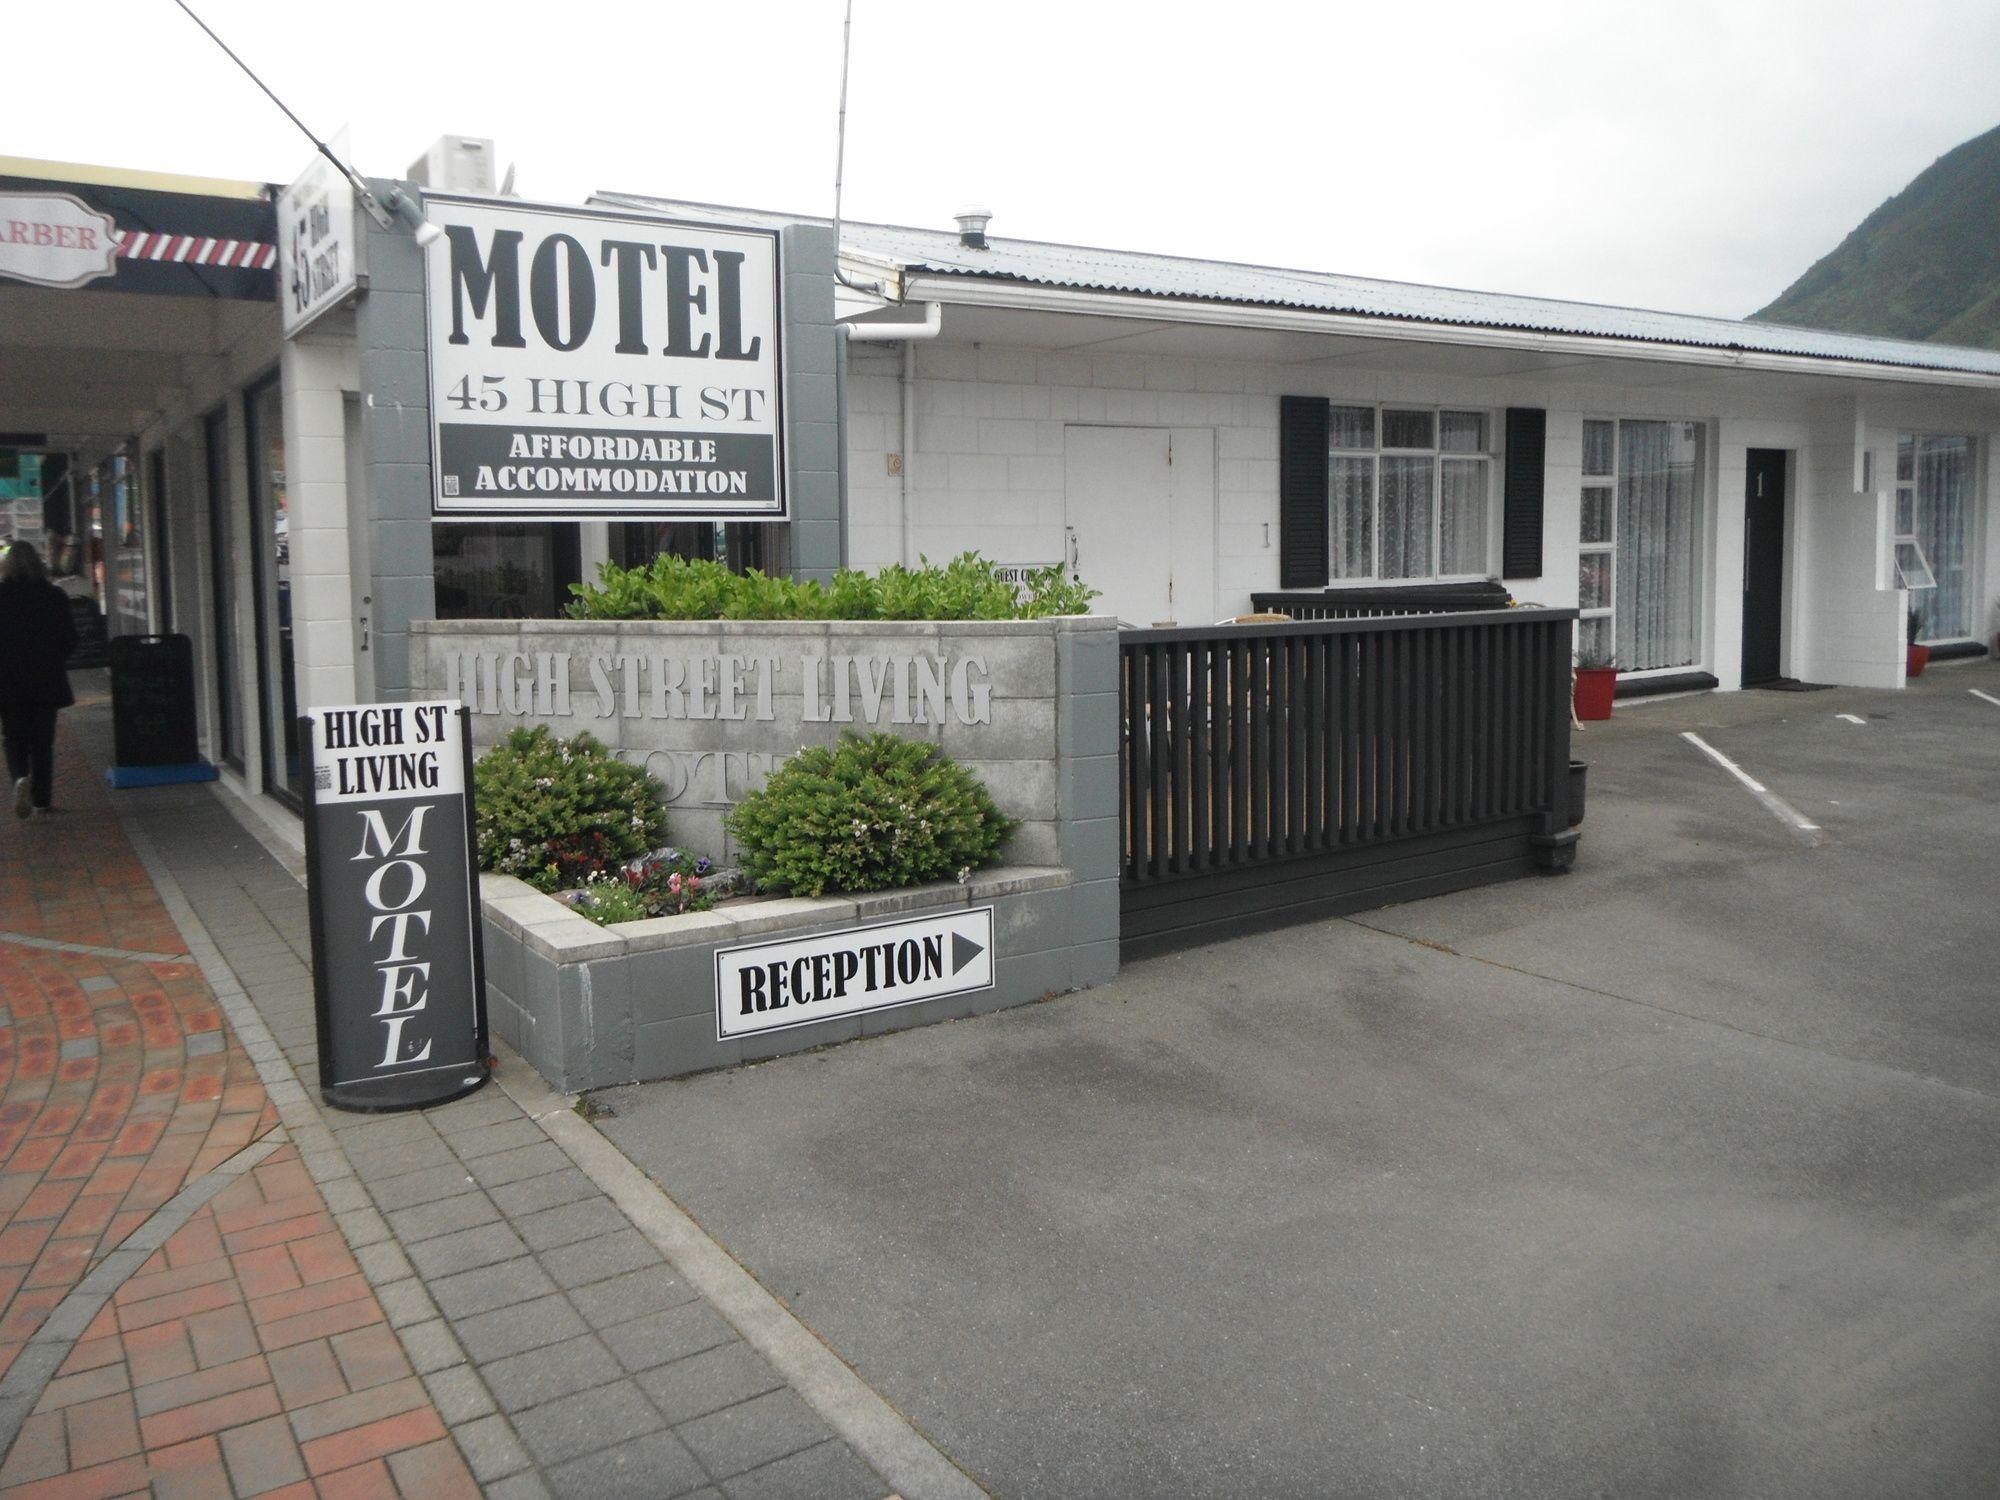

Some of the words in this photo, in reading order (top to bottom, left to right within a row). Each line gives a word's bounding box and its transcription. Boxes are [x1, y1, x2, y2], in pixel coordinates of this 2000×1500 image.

[0, 220, 98, 250] RBER
[444, 224, 762, 362] MOTEL
[446, 374, 509, 412] 45
[526, 377, 682, 420] HIGH
[700, 386, 766, 422] ST
[509, 433, 718, 464] AFFORDABLE
[475, 465, 747, 495] ACCOMMODATION
[1756, 472, 1763, 497] 1
[446, 651, 573, 717] HIGH
[588, 654, 782, 721] STREET
[801, 655, 993, 726] LIVING
[323, 706, 404, 750] HIGH
[415, 705, 448, 744] ST
[336, 752, 440, 795] LIVING
[349, 805, 436, 1069] MOTEL
[738, 934, 944, 1016] RECEPTION
